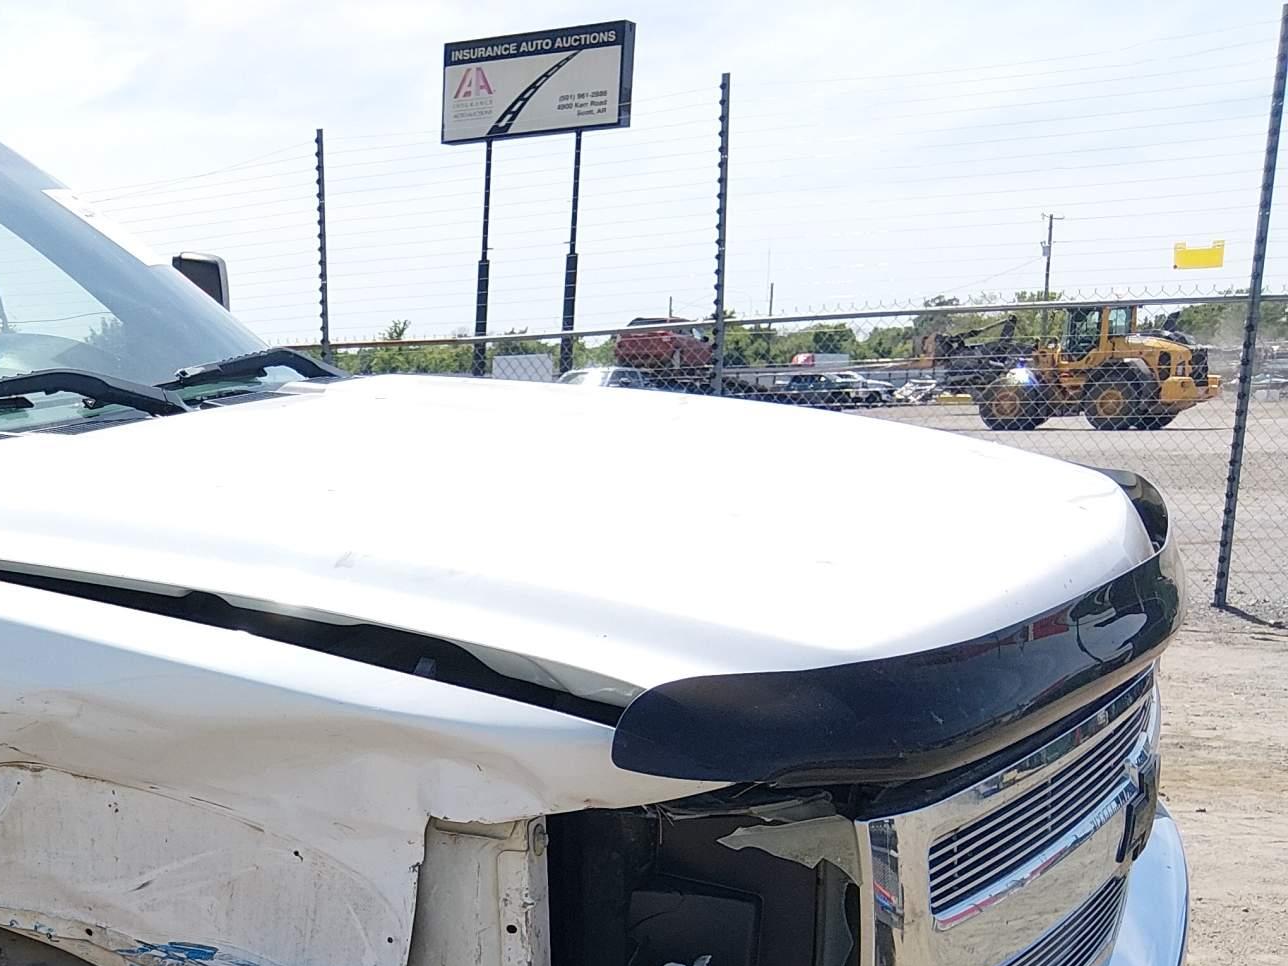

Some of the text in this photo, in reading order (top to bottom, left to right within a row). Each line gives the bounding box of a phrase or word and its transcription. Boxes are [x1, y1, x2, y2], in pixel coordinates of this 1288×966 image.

[451, 30, 616, 61] INSURANCE AUTO AUCTIONS
